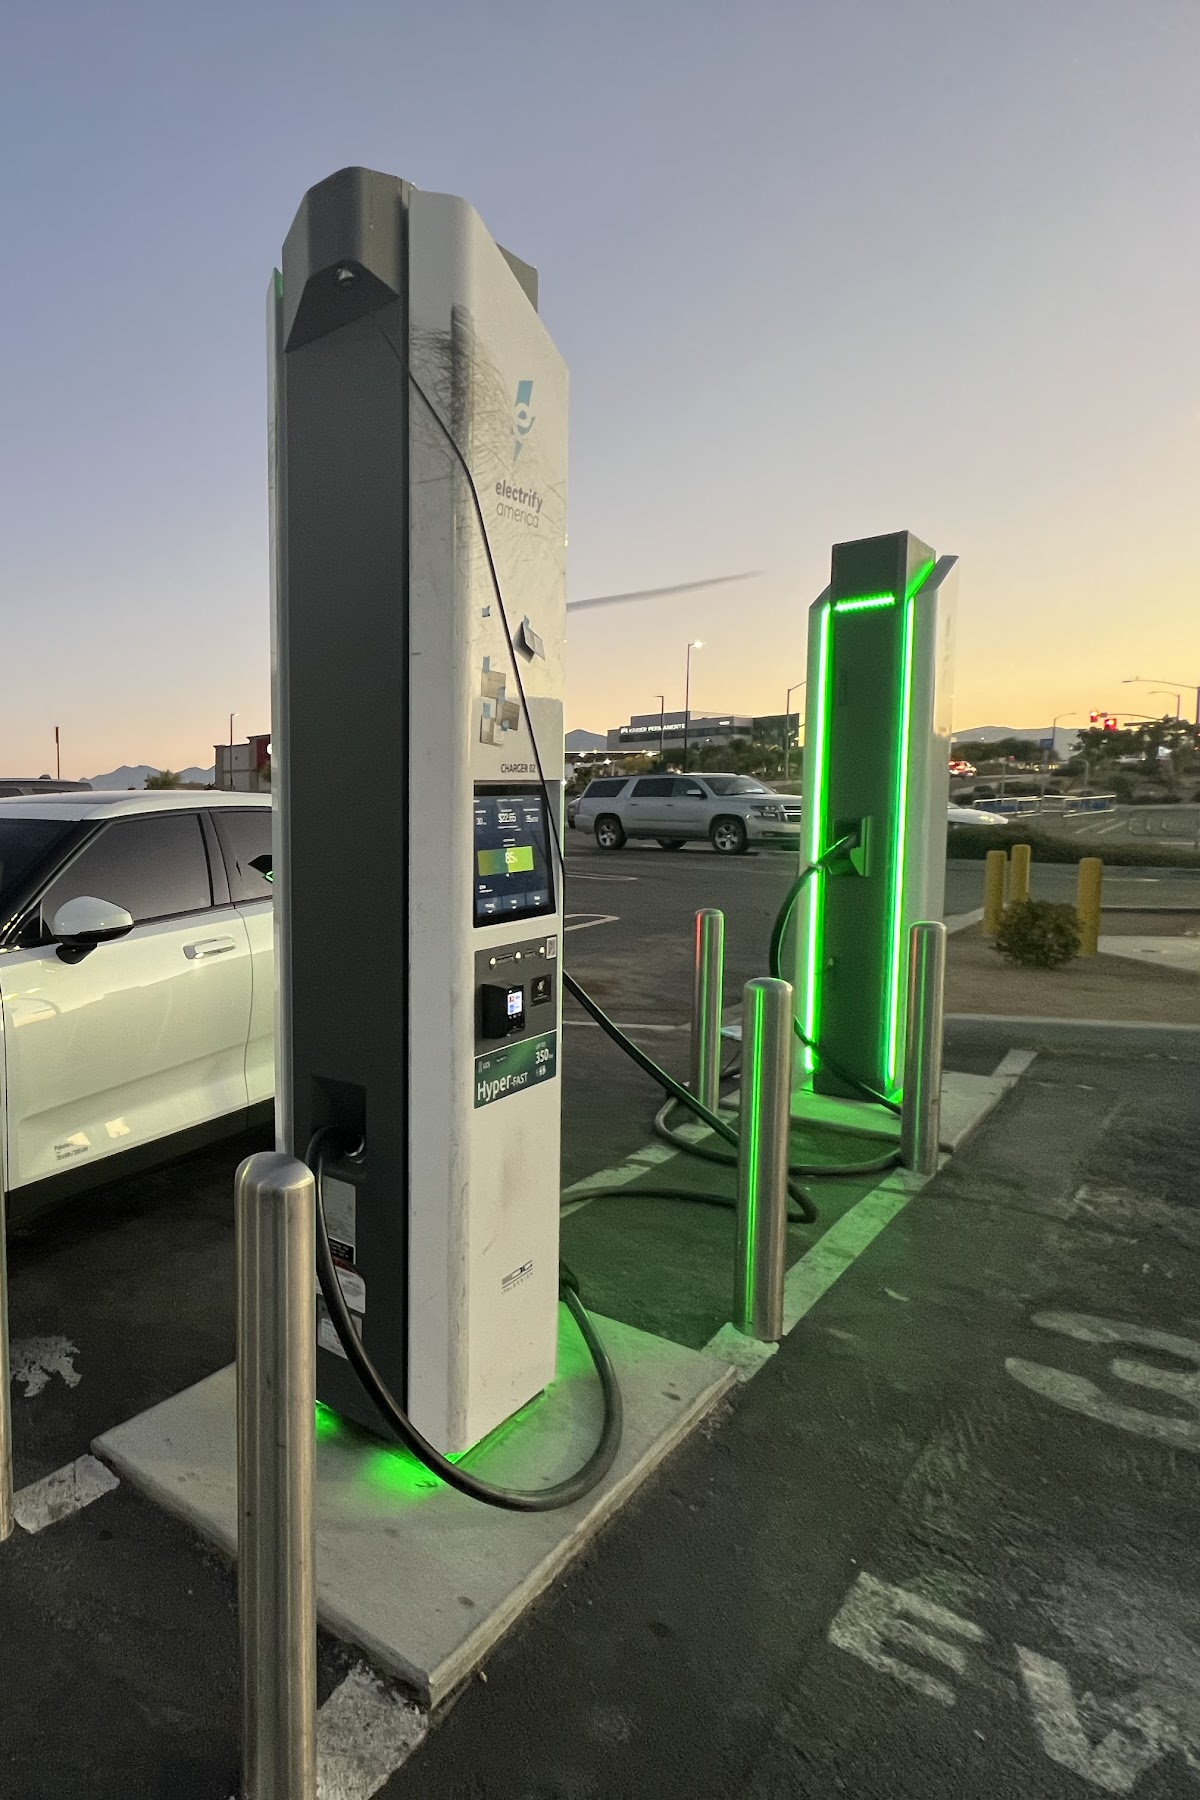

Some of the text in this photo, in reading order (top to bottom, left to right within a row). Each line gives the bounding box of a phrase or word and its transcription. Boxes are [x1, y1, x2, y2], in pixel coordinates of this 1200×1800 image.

[495, 479, 543, 514] electrify
[496, 502, 539, 528] america
[501, 763, 528, 773] CHARGER
[535, 1048, 549, 1065] 350
